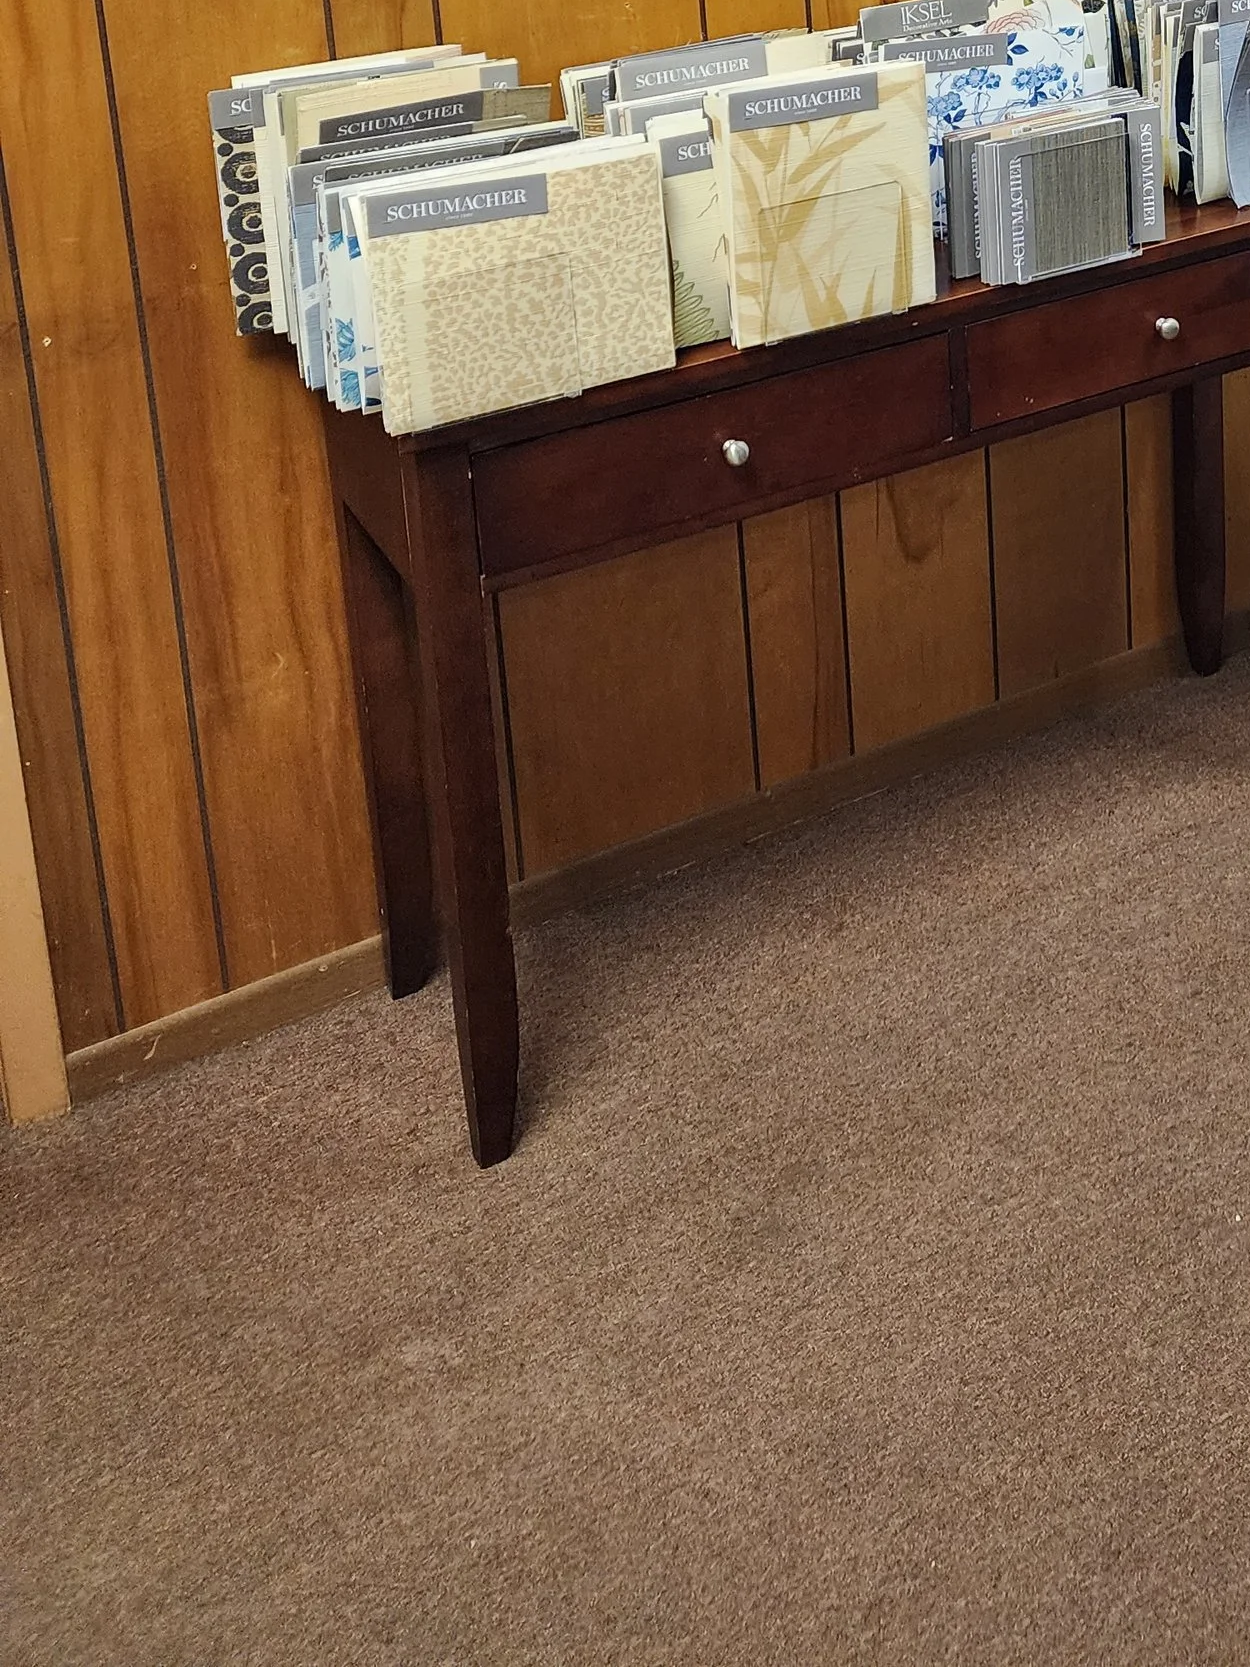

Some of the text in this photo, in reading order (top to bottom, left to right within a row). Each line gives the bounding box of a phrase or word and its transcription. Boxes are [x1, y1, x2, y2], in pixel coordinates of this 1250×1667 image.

[901, 0, 952, 24] IKSEL
[903, 18, 953, 32] Decorative Arts
[899, 44, 994, 62] SCHUMACHER
[634, 57, 750, 89] SCHUMACHER
[744, 85, 862, 118] SCHUMACHER
[337, 103, 464, 137] SCHUMACHER
[1138, 123, 1156, 227] SCHUMACHER
[385, 189, 527, 223] SCHUMACHER
[1008, 157, 1025, 266] SCHUMACHER
